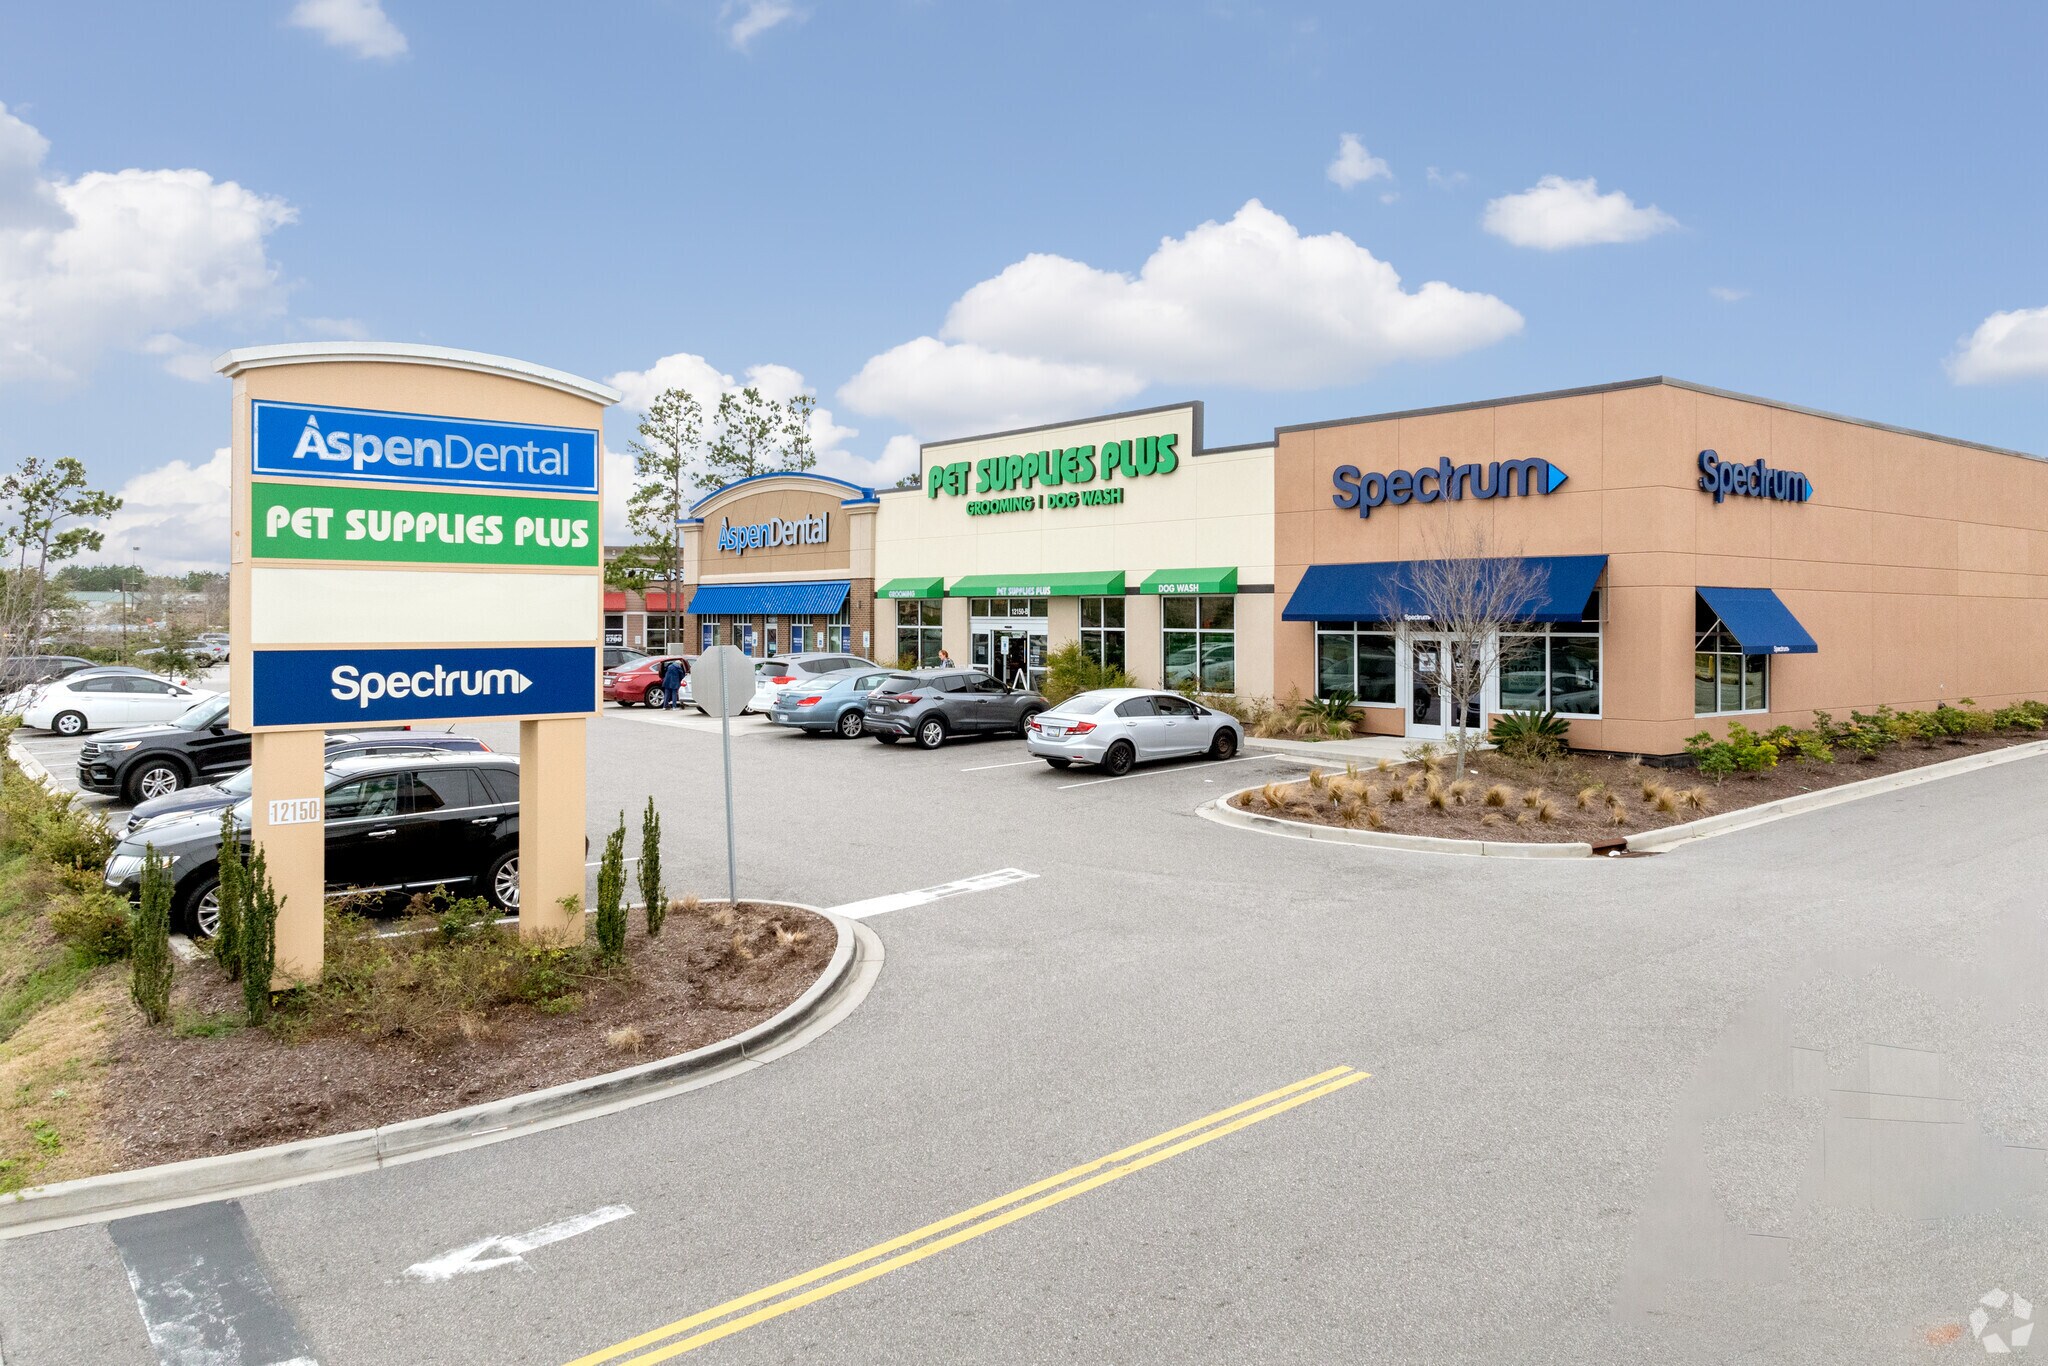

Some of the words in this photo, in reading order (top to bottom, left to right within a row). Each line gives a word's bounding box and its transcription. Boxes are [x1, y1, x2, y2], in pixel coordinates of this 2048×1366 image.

[928, 461, 972, 499] PET
[976, 445, 1096, 493] SUPPLIES
[1101, 433, 1179, 480] PLUS
[1698, 449, 1806, 503] Spectrum
[1332, 456, 1550, 518] Spectrum
[966, 496, 1035, 516] GROOMING
[1048, 492, 1079, 509] DOG
[1081, 488, 1125, 506] WASH
[265, 505, 334, 540] PET
[345, 509, 503, 545] SUPPLIES
[515, 516, 589, 548] PLUS
[888, 590, 916, 598] GROOMING
[996, 586, 1007, 596] PET
[1008, 586, 1035, 596] SUPPLIES
[1036, 586, 1051, 595] PLUS
[1158, 584, 1175, 593] DOG
[1177, 583, 1199, 592] WASH
[1404, 614, 1428, 622] Spectrum
[331, 664, 520, 709] Spectrum
[272, 800, 317, 822] 12150
